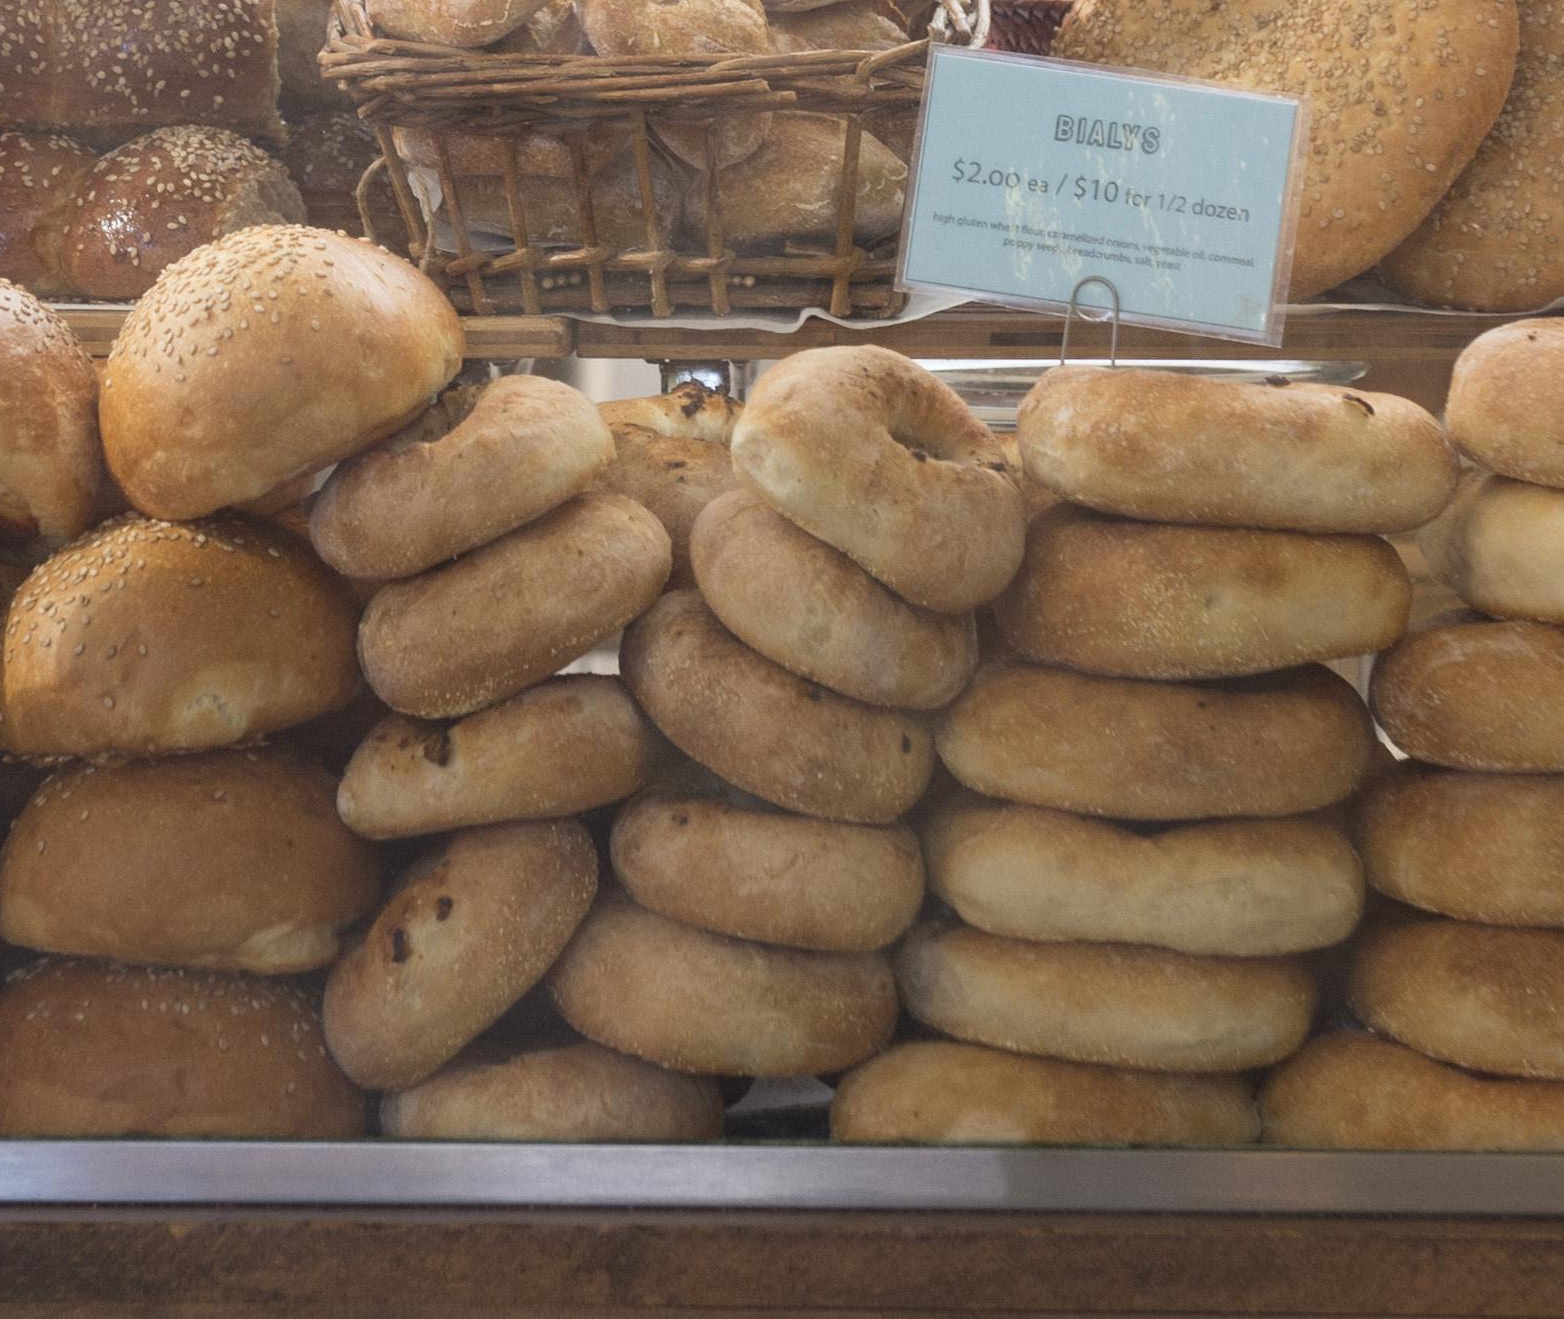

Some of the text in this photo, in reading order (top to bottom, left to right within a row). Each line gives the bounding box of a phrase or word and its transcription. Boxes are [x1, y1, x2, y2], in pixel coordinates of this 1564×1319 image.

[1054, 114, 1162, 155] BIALYS
[952, 157, 1250, 223] $2.00 ea / $10 for 1/2 dozen
[932, 211, 956, 226] high
[957, 215, 989, 231] gluten
[990, 221, 1020, 234] whet
